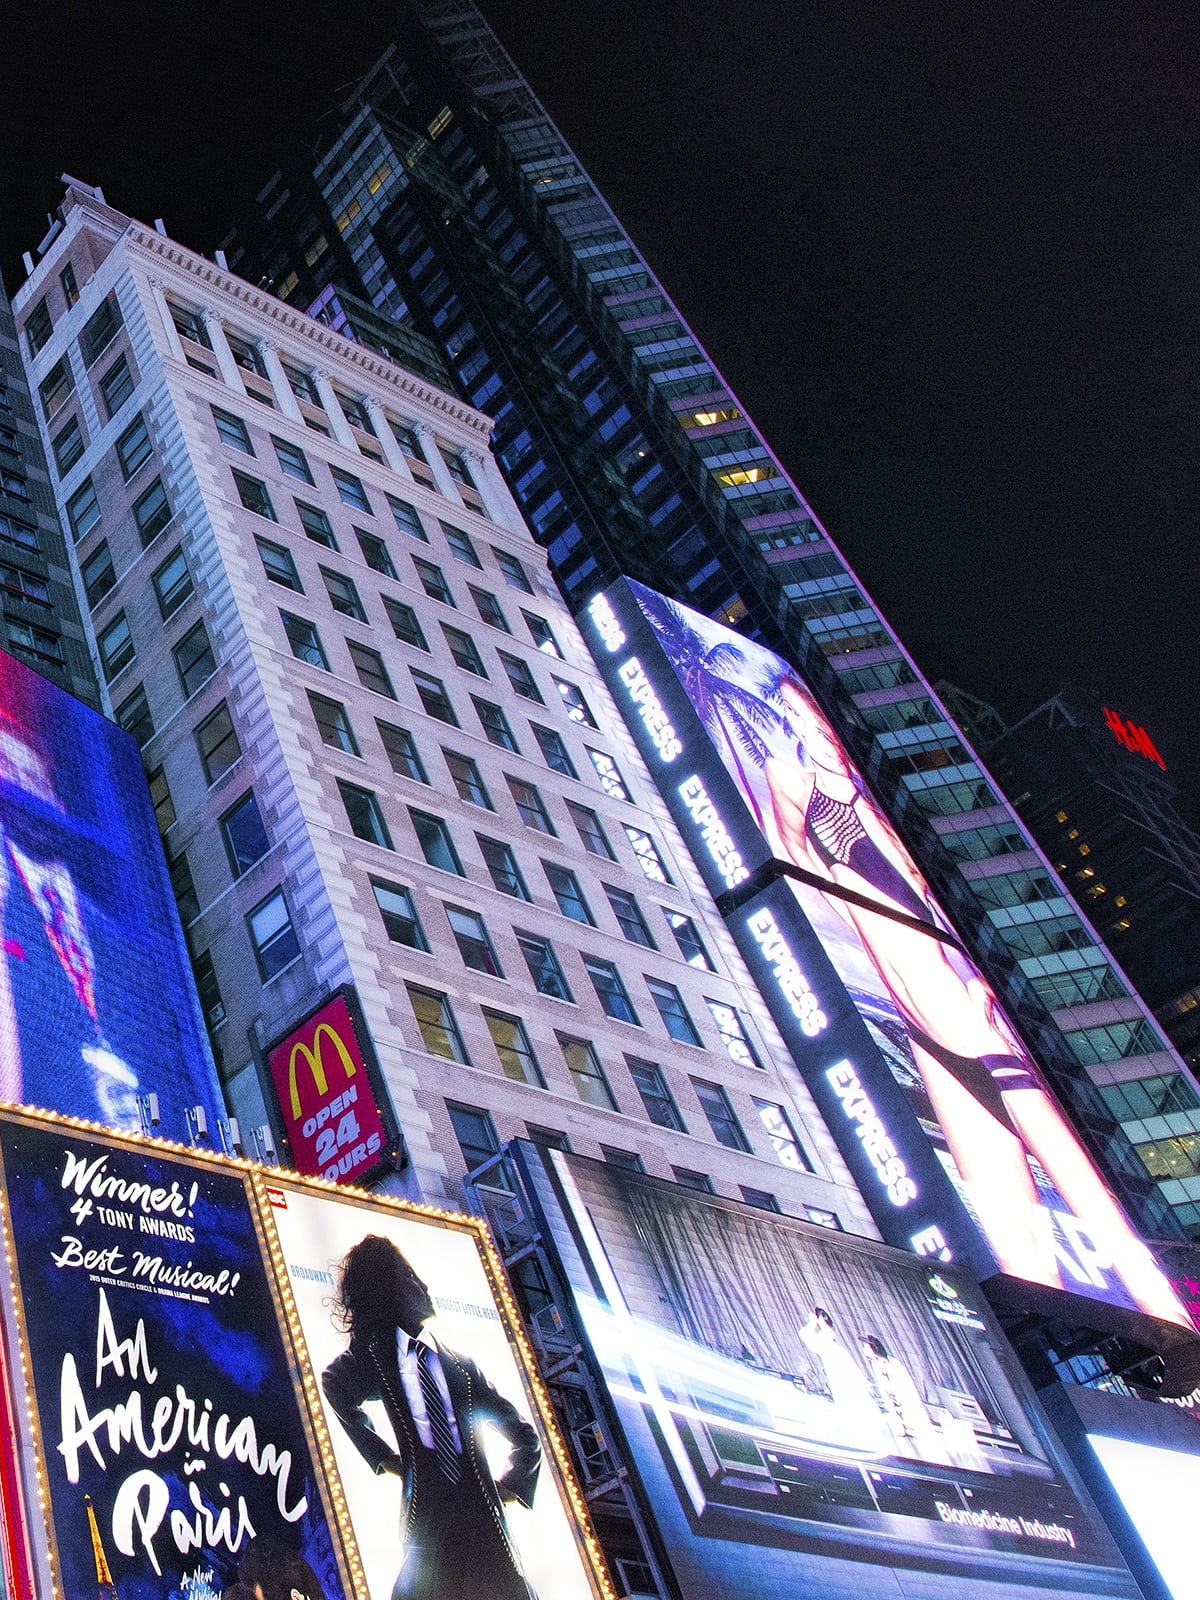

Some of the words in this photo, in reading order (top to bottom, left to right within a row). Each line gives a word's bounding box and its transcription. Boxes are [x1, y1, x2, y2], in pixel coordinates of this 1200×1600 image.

[617, 656, 683, 763] EXPRESS
[678, 774, 750, 890] EXPRESS
[746, 906, 828, 1038] EXPRESS
[302, 1084, 358, 1138] OPEN
[315, 1109, 361, 1167] 24
[825, 1058, 919, 1207] EXPRESS
[60, 1150, 199, 1217] Winner!
[317, 1132, 381, 1183] OURS
[69, 1197, 94, 1226] 4
[97, 1206, 134, 1231] TONY
[140, 1215, 195, 1243] AWARDS
[50, 1235, 129, 1273] Best
[132, 1250, 241, 1297] Musical!
[290, 1264, 335, 1286] BROADWAY'S
[96, 1287, 158, 1388] An
[461, 1302, 483, 1318] LITTLE
[56, 1352, 309, 1522] American
[183, 1451, 206, 1475] in
[112, 1469, 257, 1576] Paris
[933, 1500, 1021, 1539] Biomedicine
[1021, 1515, 1076, 1549] Industry
[180, 1571, 190, 1591] A
[190, 1564, 215, 1591] New
